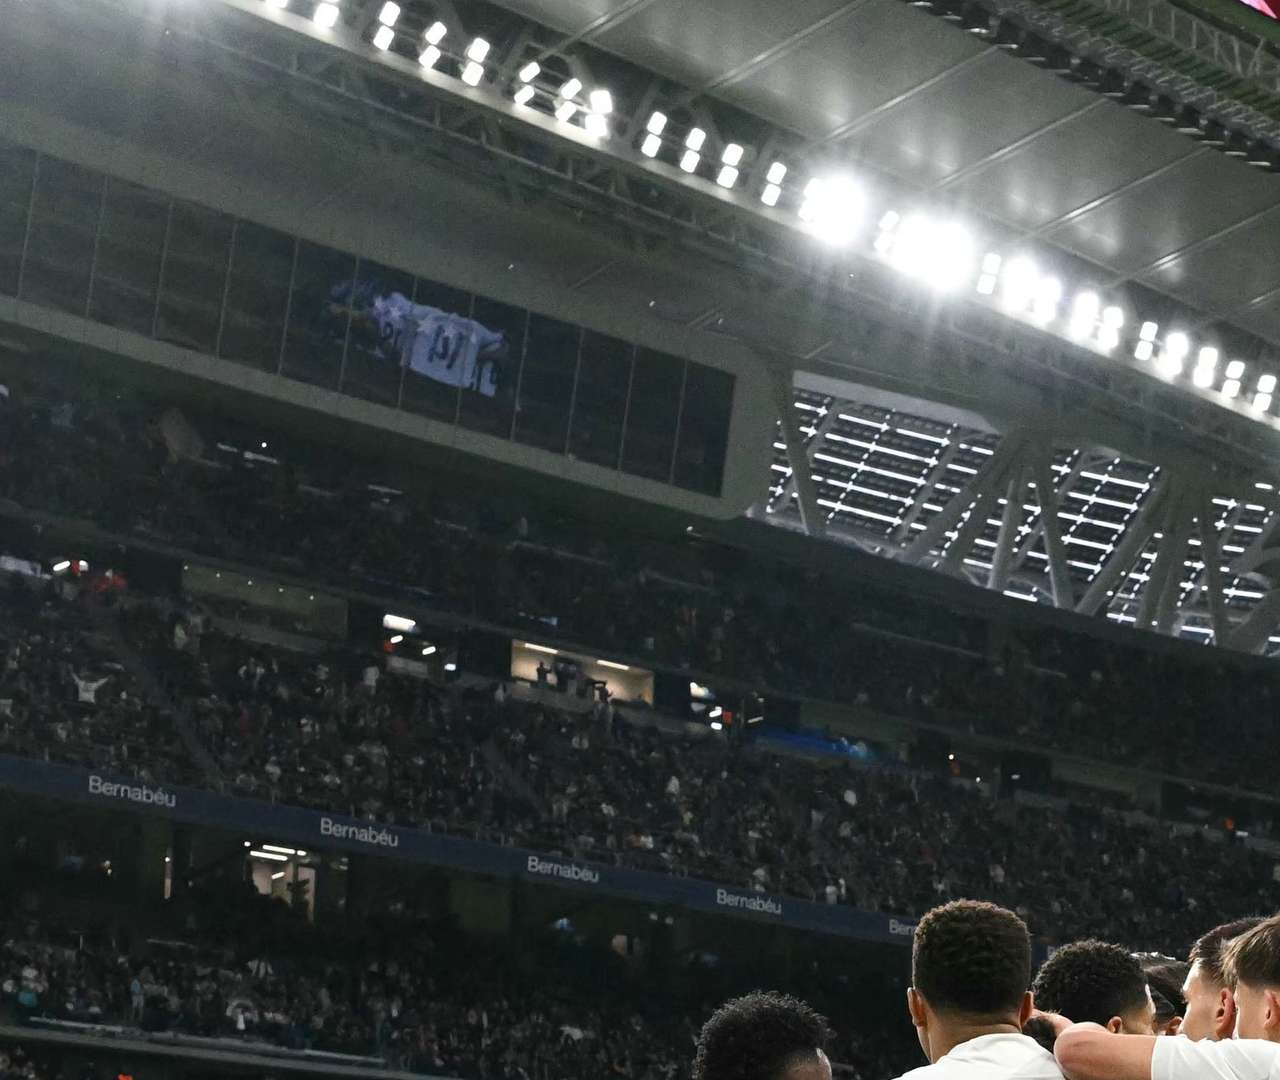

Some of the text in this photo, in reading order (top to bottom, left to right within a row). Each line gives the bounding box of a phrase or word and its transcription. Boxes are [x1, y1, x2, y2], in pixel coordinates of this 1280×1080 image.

[88, 775, 176, 808] Bernabéu
[320, 817, 398, 847] Bernabéu
[527, 856, 600, 884] Bernabéu
[716, 888, 782, 916] Bernabéu
